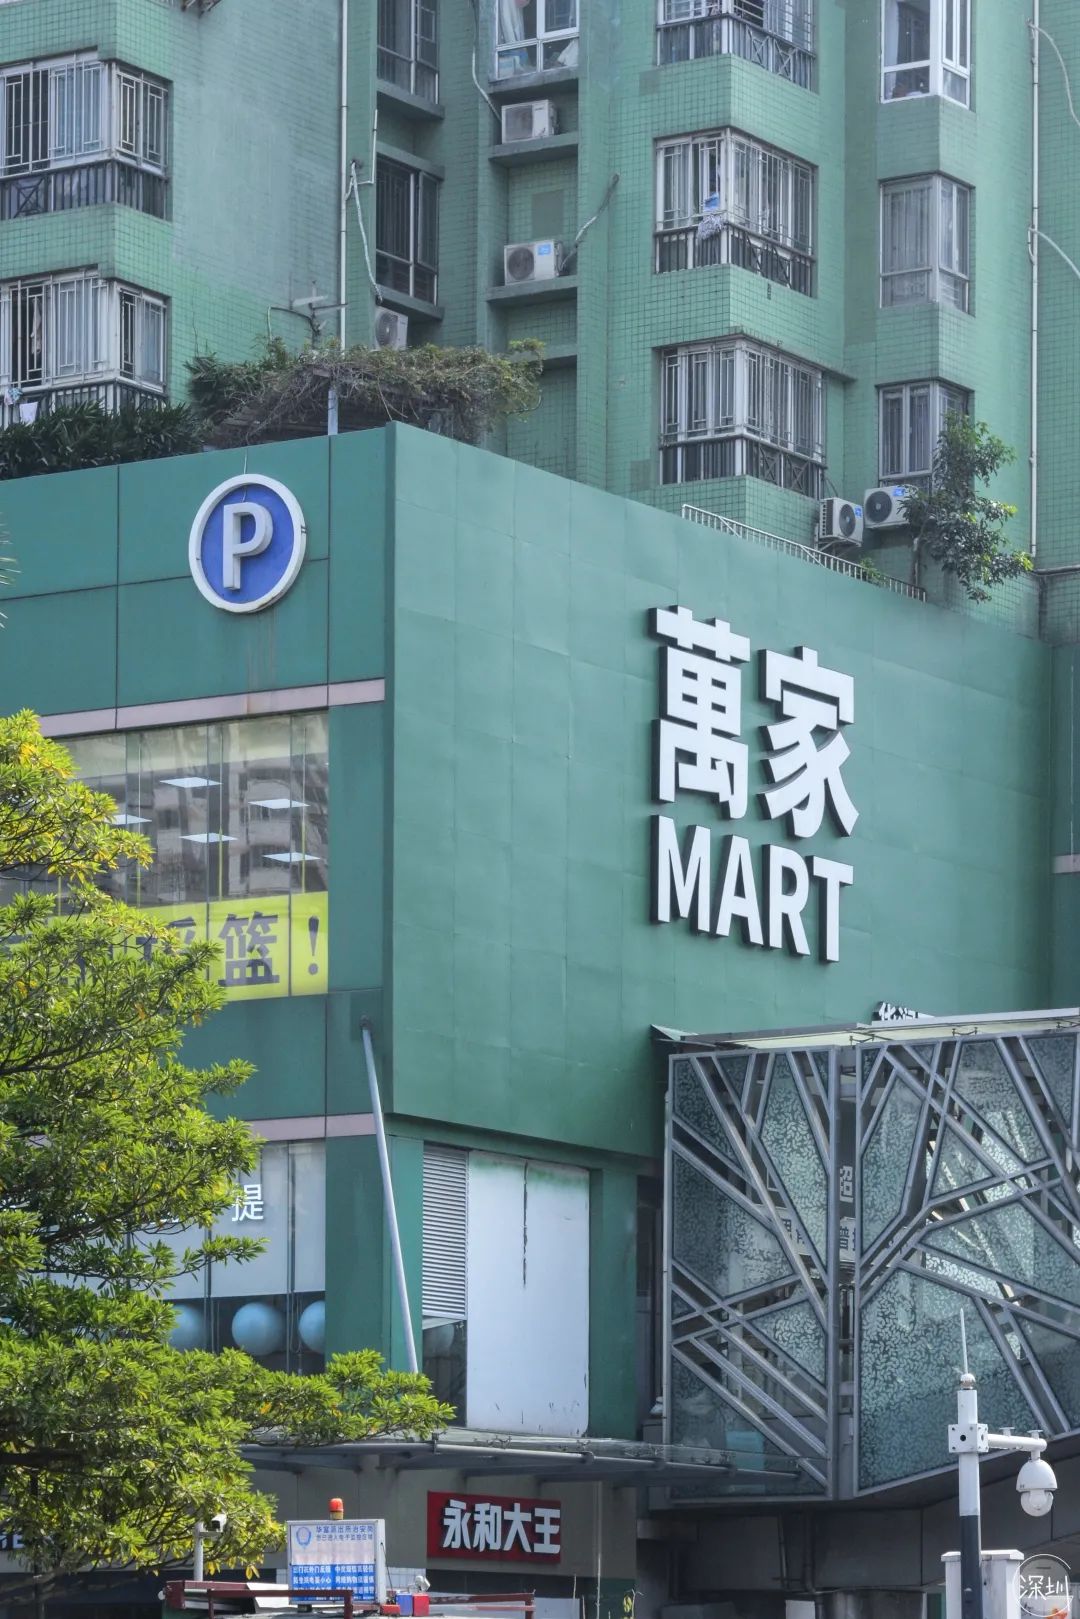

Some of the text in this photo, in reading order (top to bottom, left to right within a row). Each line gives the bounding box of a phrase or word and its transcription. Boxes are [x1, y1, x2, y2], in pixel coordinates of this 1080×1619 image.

[223, 502, 273, 590] P
[650, 605, 860, 838] 萬家
[651, 815, 854, 962] MART
[442, 1499, 560, 1554] 永和大王
